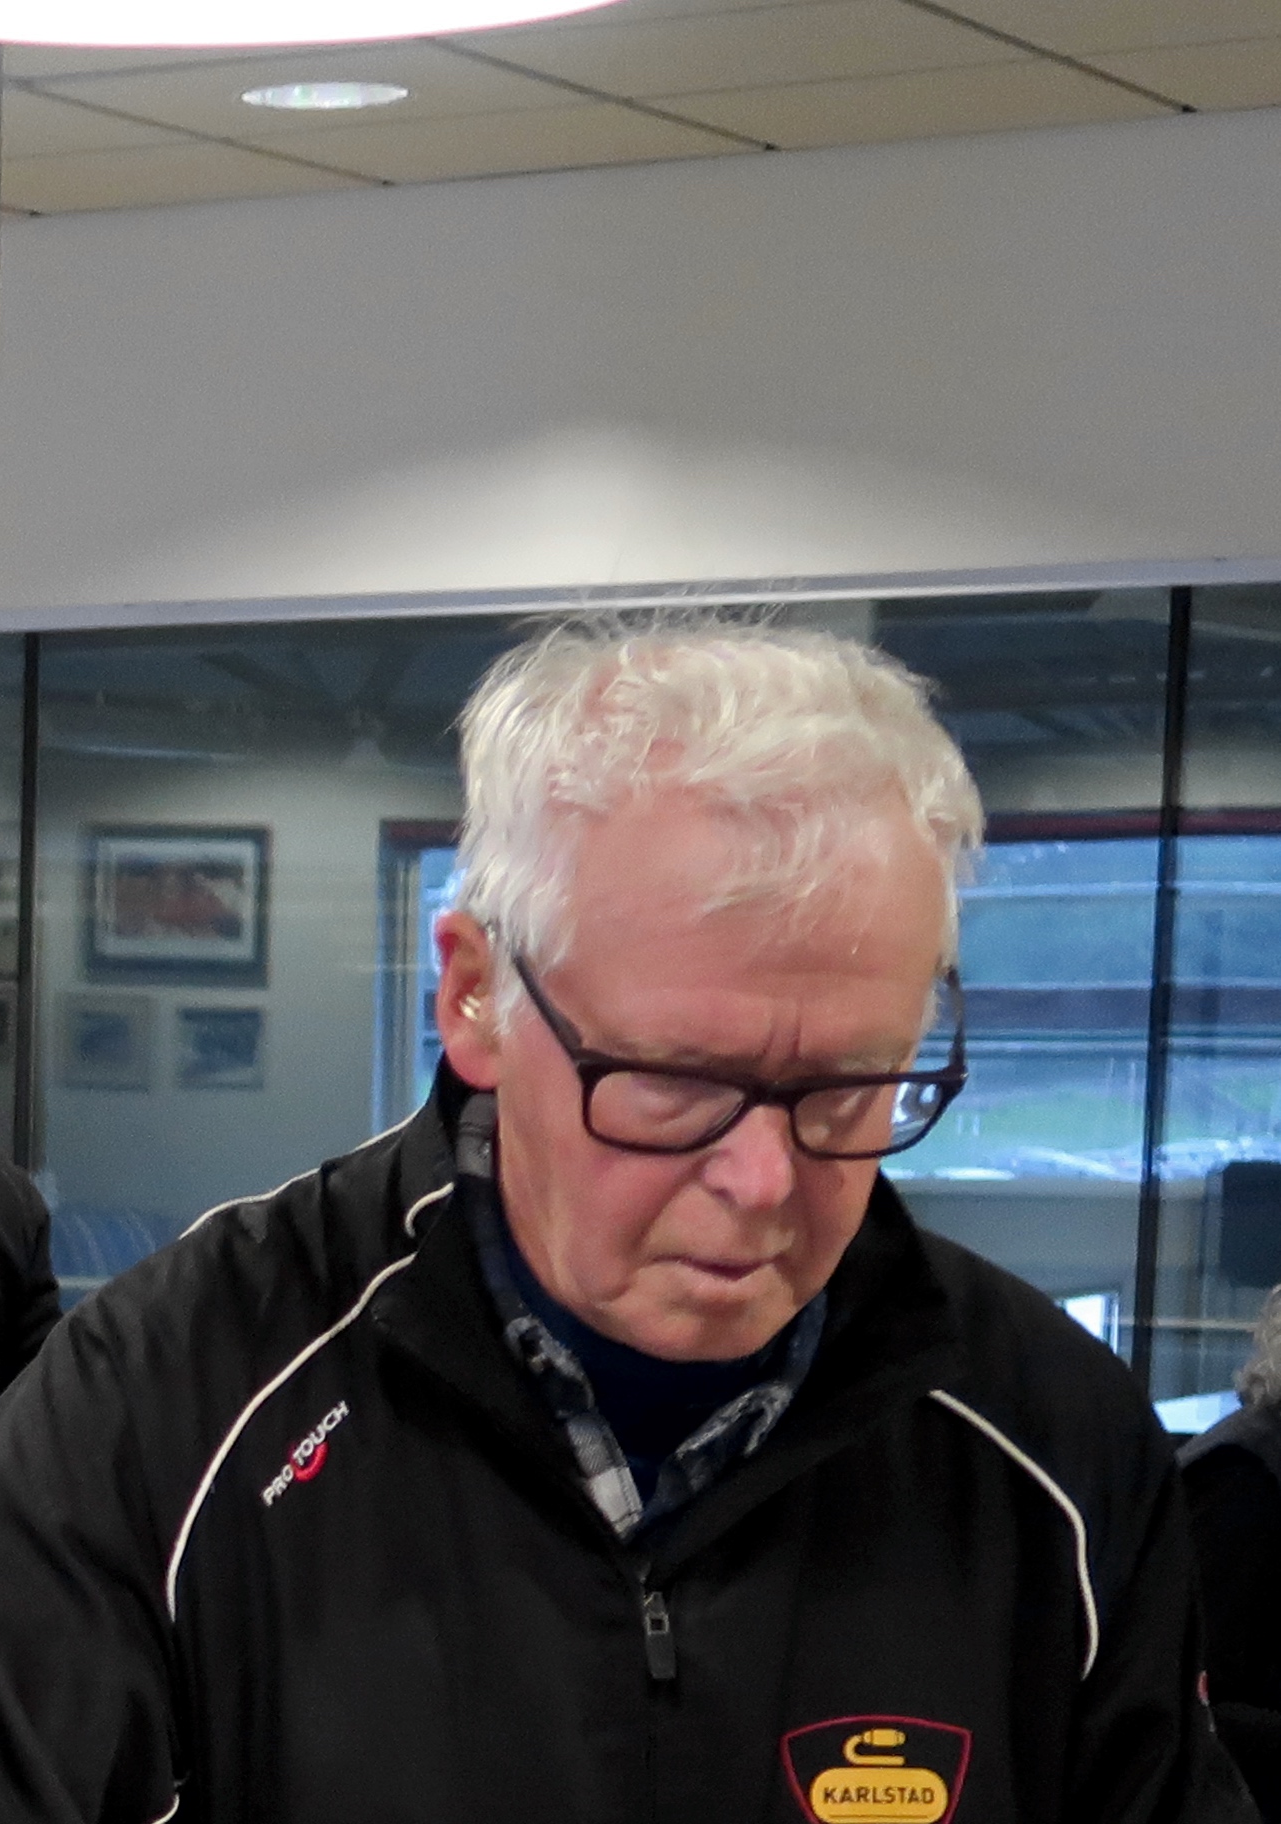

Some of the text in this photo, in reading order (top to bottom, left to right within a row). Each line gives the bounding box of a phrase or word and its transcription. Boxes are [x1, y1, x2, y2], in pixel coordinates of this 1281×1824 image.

[262, 1400, 349, 1507] PRO TOUCH
[823, 1786, 934, 1804] KARLSTAD
